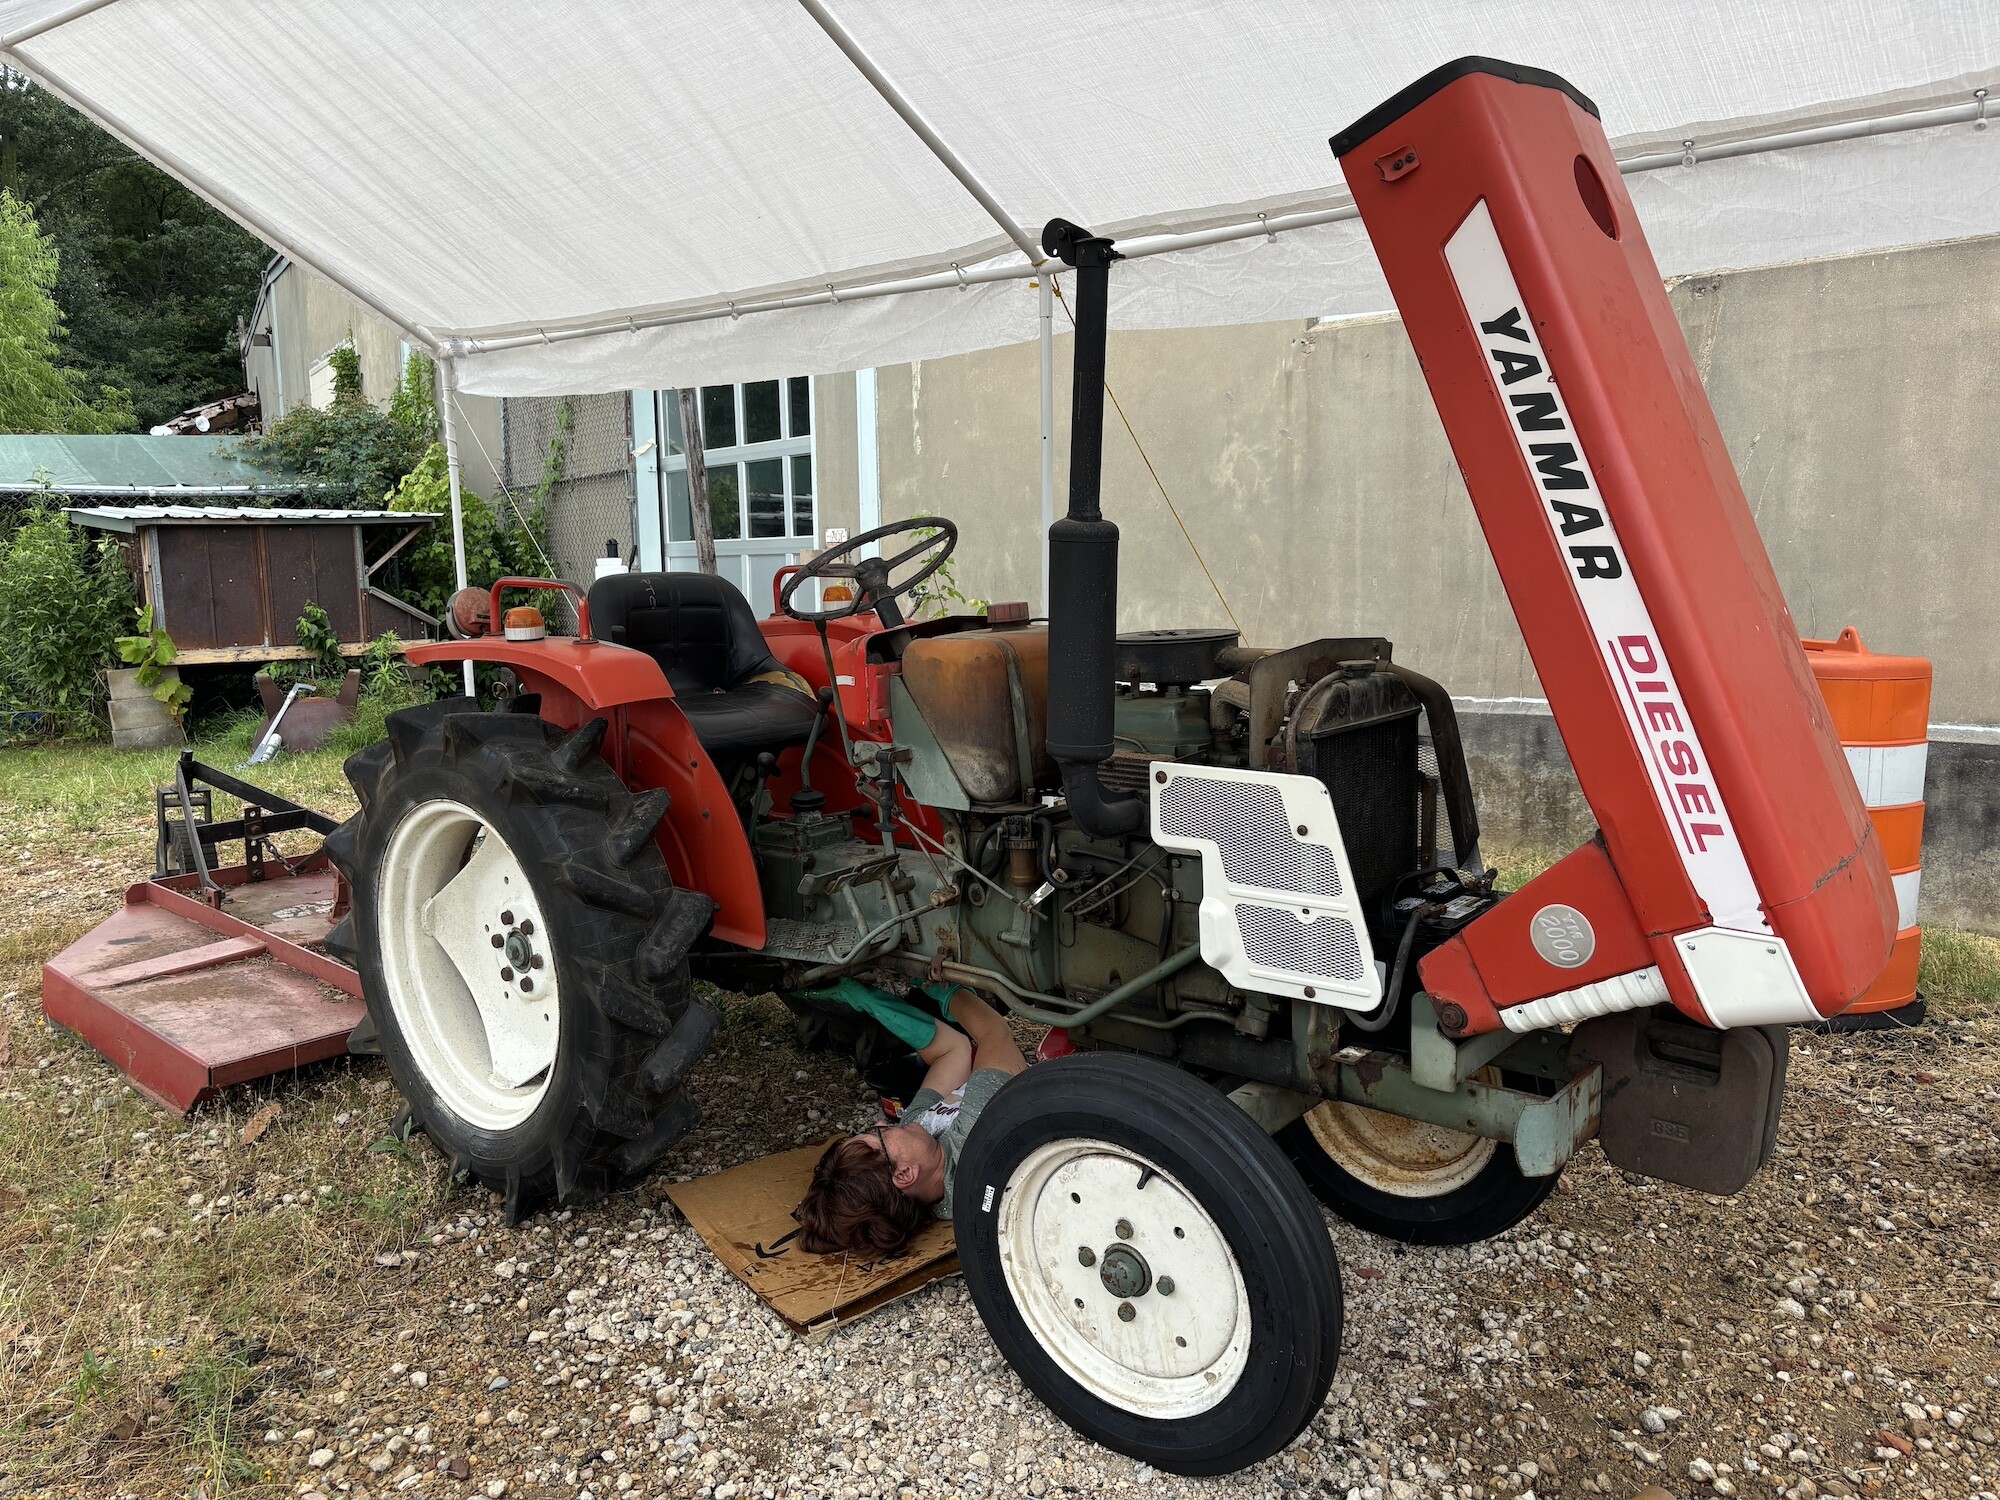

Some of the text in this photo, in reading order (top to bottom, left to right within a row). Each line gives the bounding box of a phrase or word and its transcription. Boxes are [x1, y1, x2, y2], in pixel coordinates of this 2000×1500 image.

[1481, 306, 1623, 581] YANMAR
[1616, 634, 1725, 854] DIESEL
[1537, 915, 1580, 961] 2000
